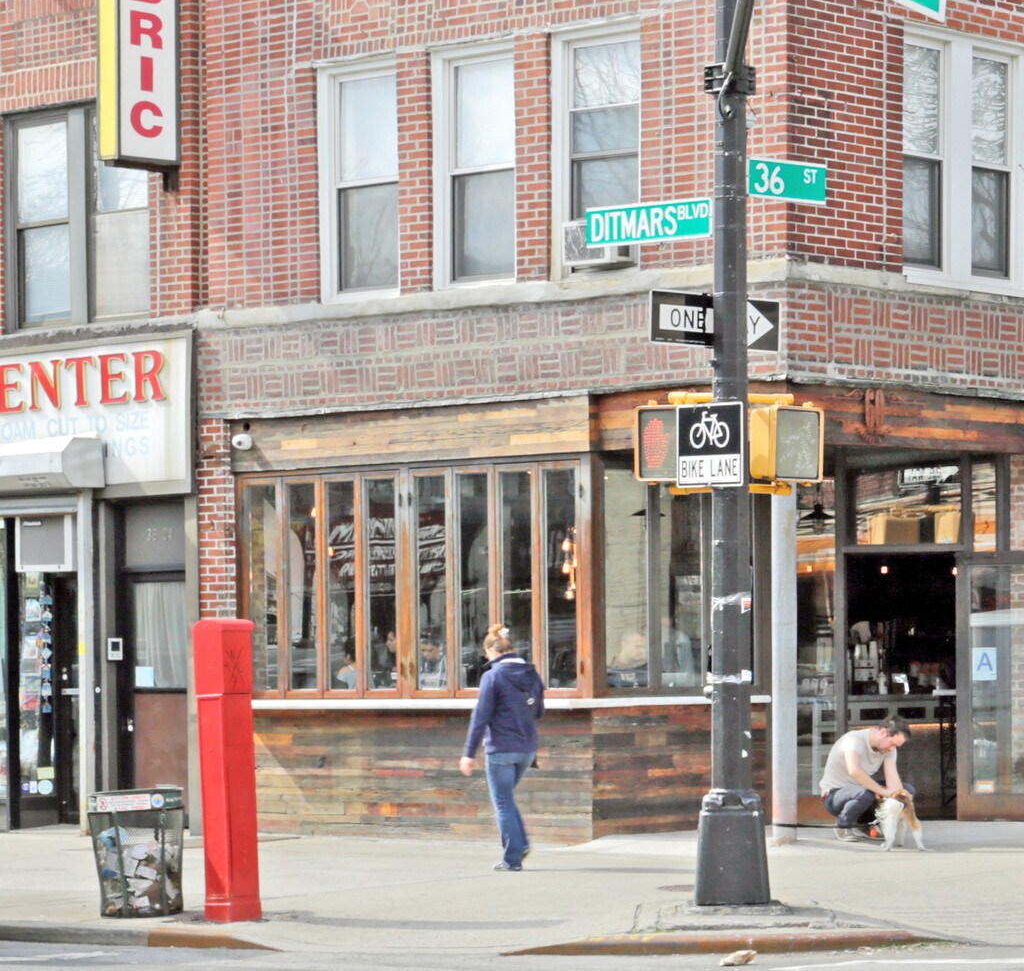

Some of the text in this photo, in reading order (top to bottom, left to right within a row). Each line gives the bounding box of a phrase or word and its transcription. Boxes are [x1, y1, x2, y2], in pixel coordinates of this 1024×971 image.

[754, 162, 818, 195] 36 ST
[590, 202, 709, 243] DITMARS BLVD
[670, 308, 705, 329] ONE
[46, 416, 80, 437] CUT
[86, 414, 107, 434] TO
[115, 409, 150, 431] SIZE
[681, 458, 738, 478] BIKE LANE
[976, 652, 993, 671] A
